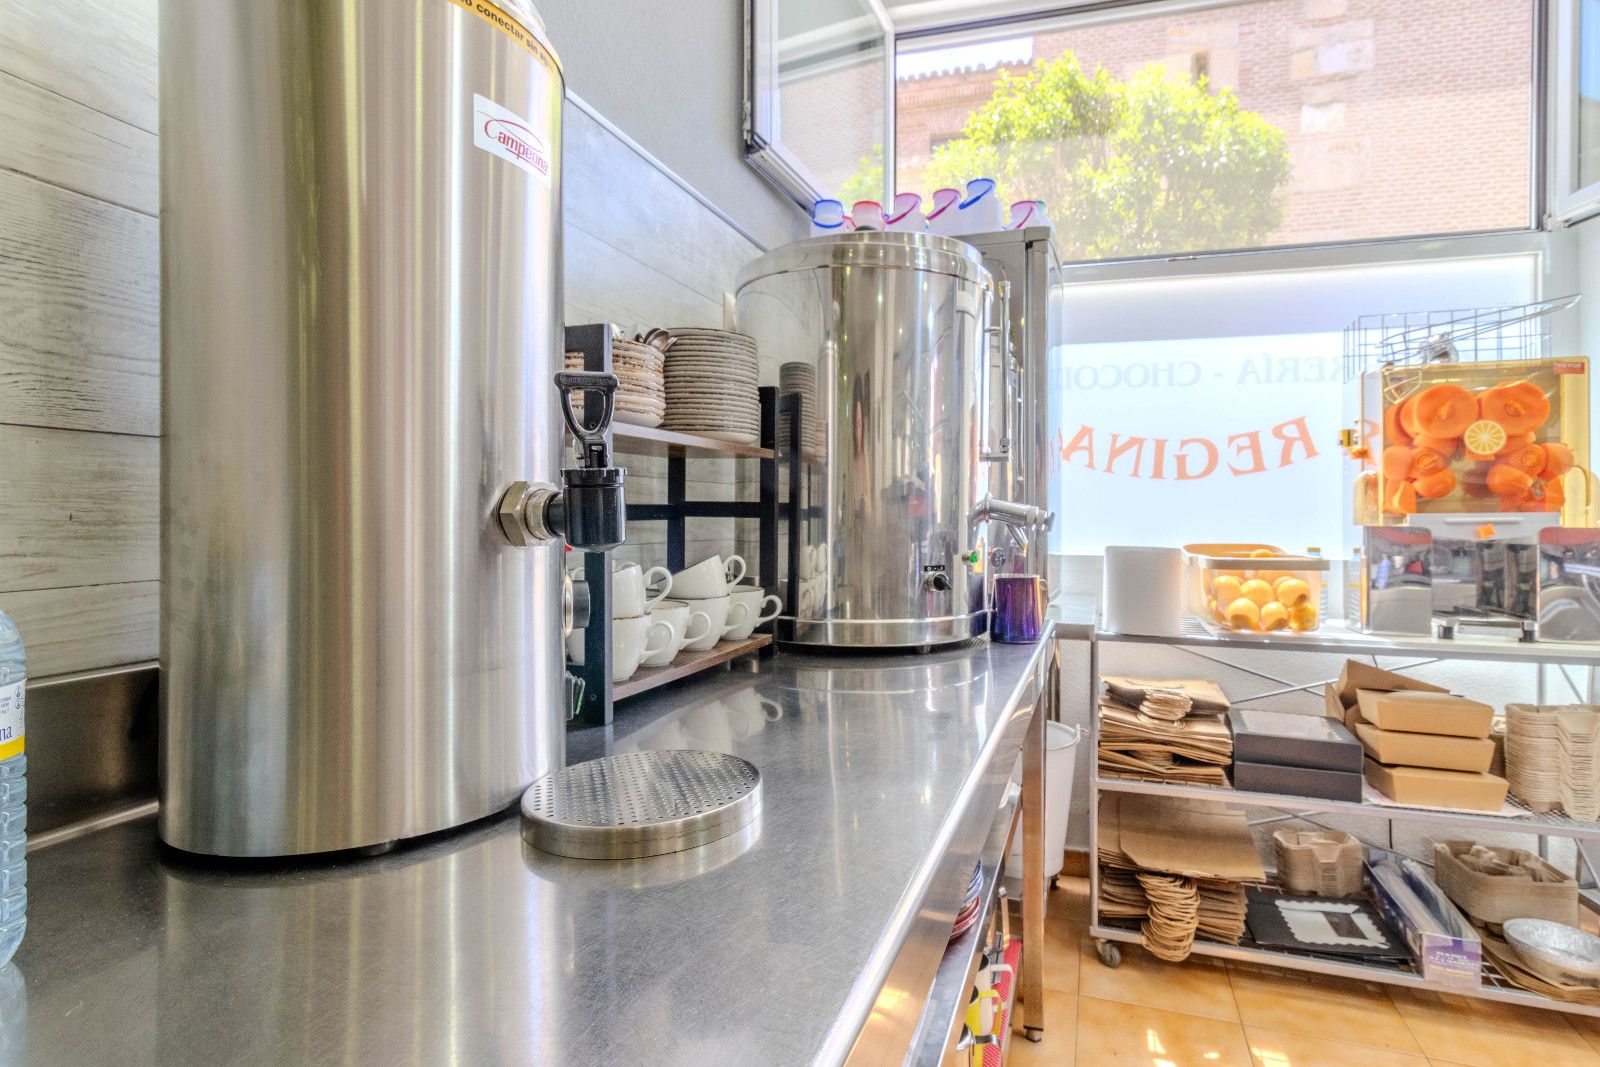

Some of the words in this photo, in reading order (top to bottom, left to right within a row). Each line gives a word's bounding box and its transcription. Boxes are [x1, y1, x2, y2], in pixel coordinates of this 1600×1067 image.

[476, 4, 523, 41] conectar
[526, 39, 538, 54] sin
[484, 119, 549, 176] Campeona
